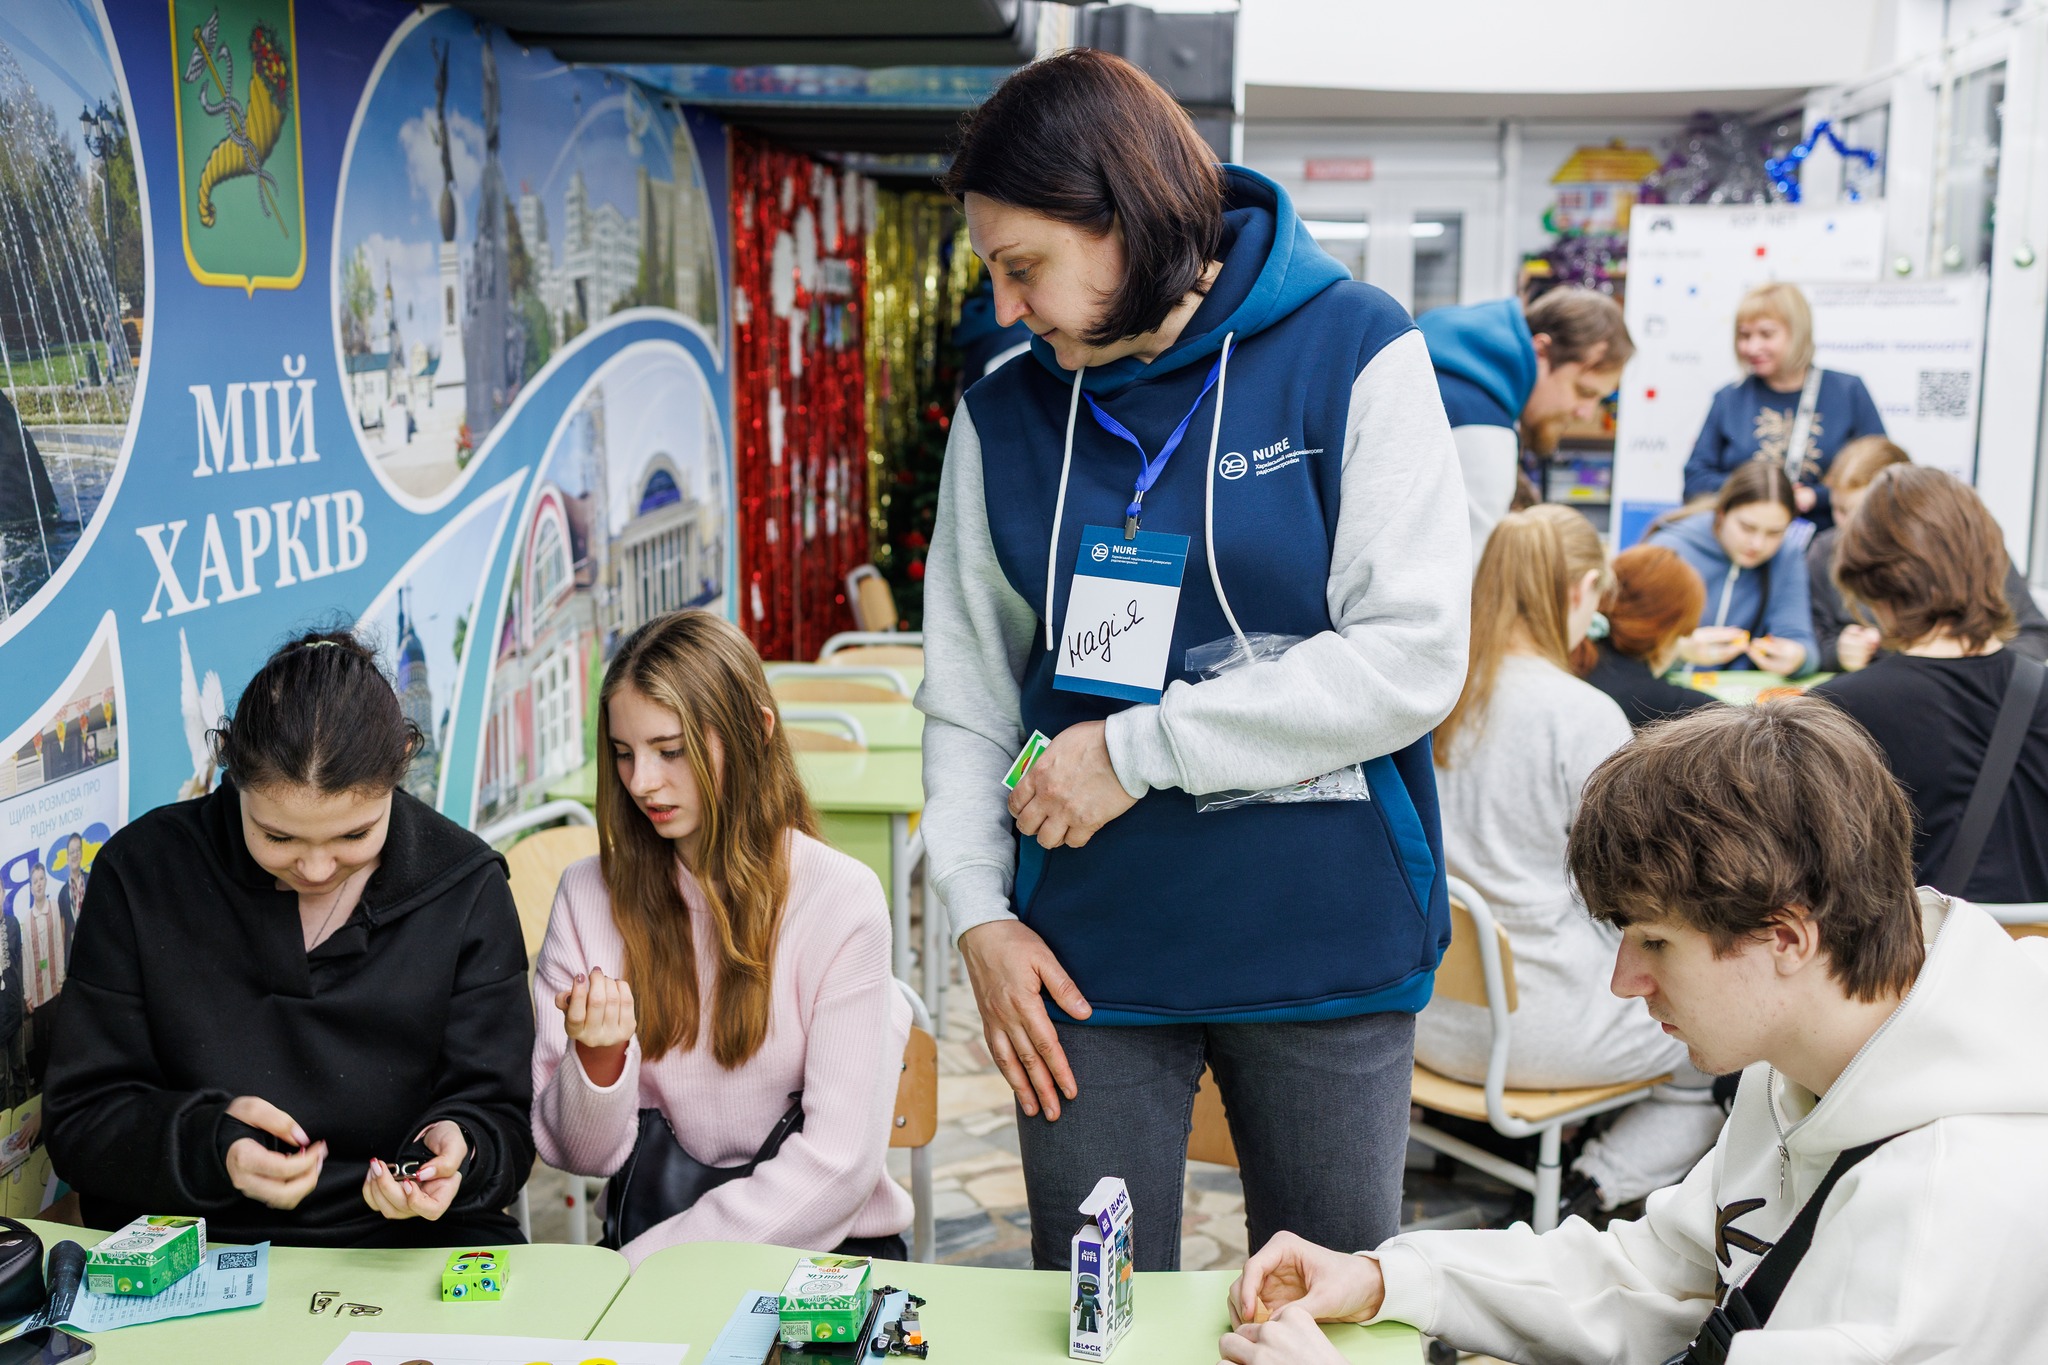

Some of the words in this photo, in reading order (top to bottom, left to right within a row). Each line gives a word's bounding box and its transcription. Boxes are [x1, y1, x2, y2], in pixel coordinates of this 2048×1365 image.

[188, 353, 321, 478] МІЙ
[1252, 437, 1290, 461] NURE
[136, 490, 369, 624] ХАРКІВ
[1112, 545, 1138, 555] NURE
[9, 803, 37, 826] ЩИРА
[39, 786, 81, 814] РОЗМОВА
[83, 779, 101, 798] ПРО
[30, 814, 58, 839] РІДНУ
[58, 807, 84, 828] МОВУ
[1081, 1252, 1098, 1263] hits
[1083, 1249, 1096, 1257] kids
